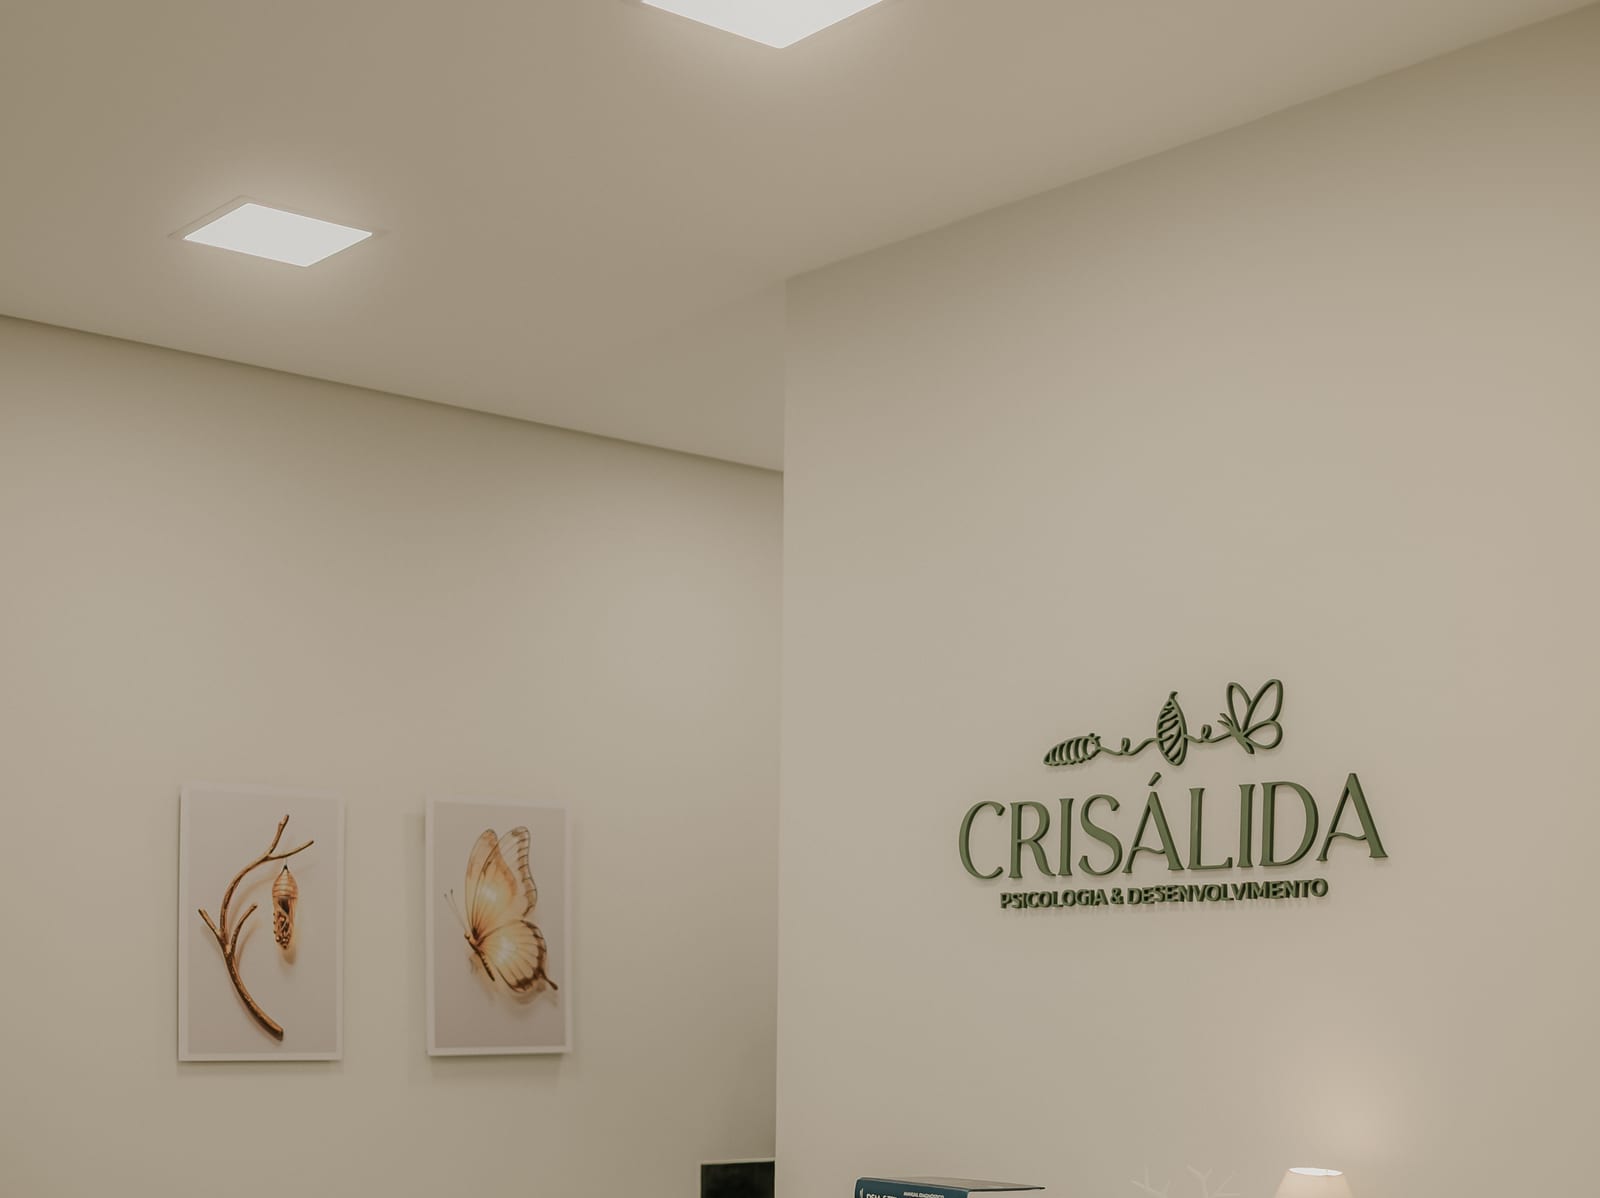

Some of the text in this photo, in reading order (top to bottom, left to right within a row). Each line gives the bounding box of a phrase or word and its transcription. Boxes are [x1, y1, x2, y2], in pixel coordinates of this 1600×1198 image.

[958, 772, 1388, 880] CRISÁLIDA
[1000, 878, 1329, 909] PSICOLOGIA & DESENVOLVIMENTO
